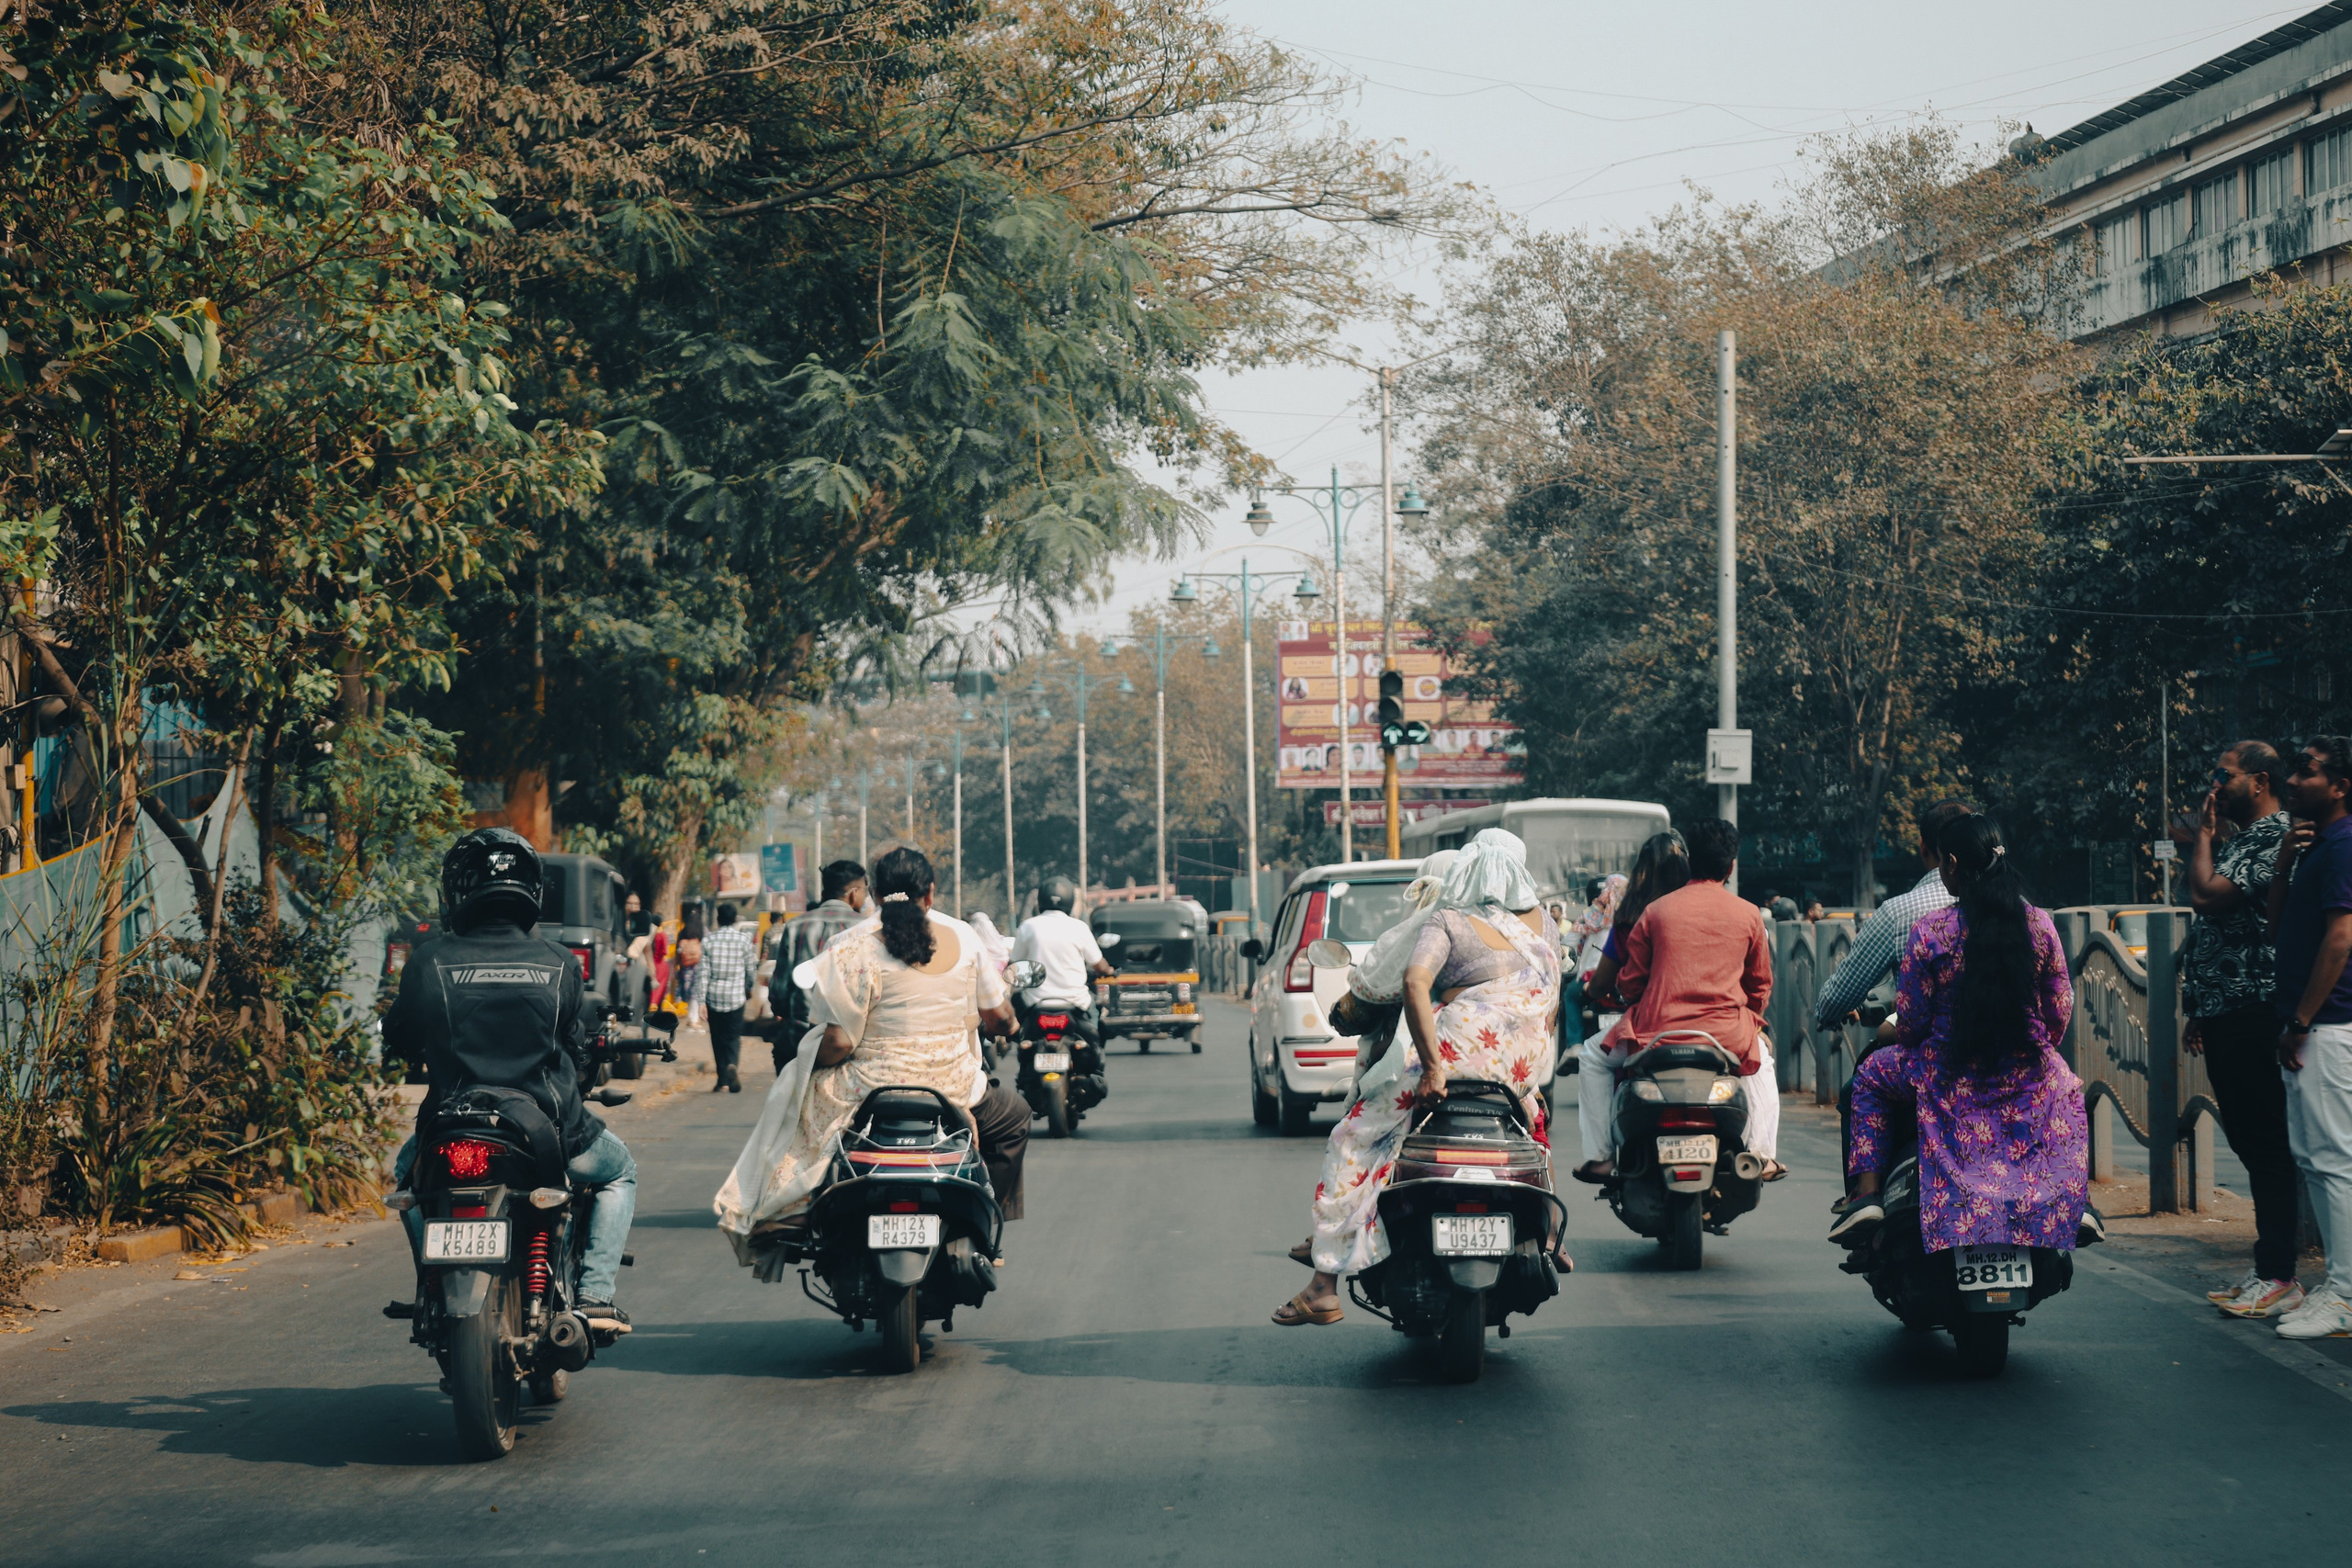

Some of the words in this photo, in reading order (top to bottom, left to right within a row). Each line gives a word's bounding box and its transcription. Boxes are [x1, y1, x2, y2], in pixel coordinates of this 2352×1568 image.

[1447, 1104, 1484, 1114] Century
[895, 1136, 918, 1145] TVS
[1664, 1146, 1711, 1160] 4120
[882, 1217, 925, 1231] MH12X
[1450, 1217, 1496, 1233] MH12Y
[444, 1224, 497, 1239] MH12X
[882, 1232, 926, 1246] R4379
[1451, 1233, 1497, 1248] U9437
[442, 1240, 497, 1256] K5489
[1966, 1252, 2018, 1265] MH.12.DH
[1958, 1263, 2029, 1285] 8811
